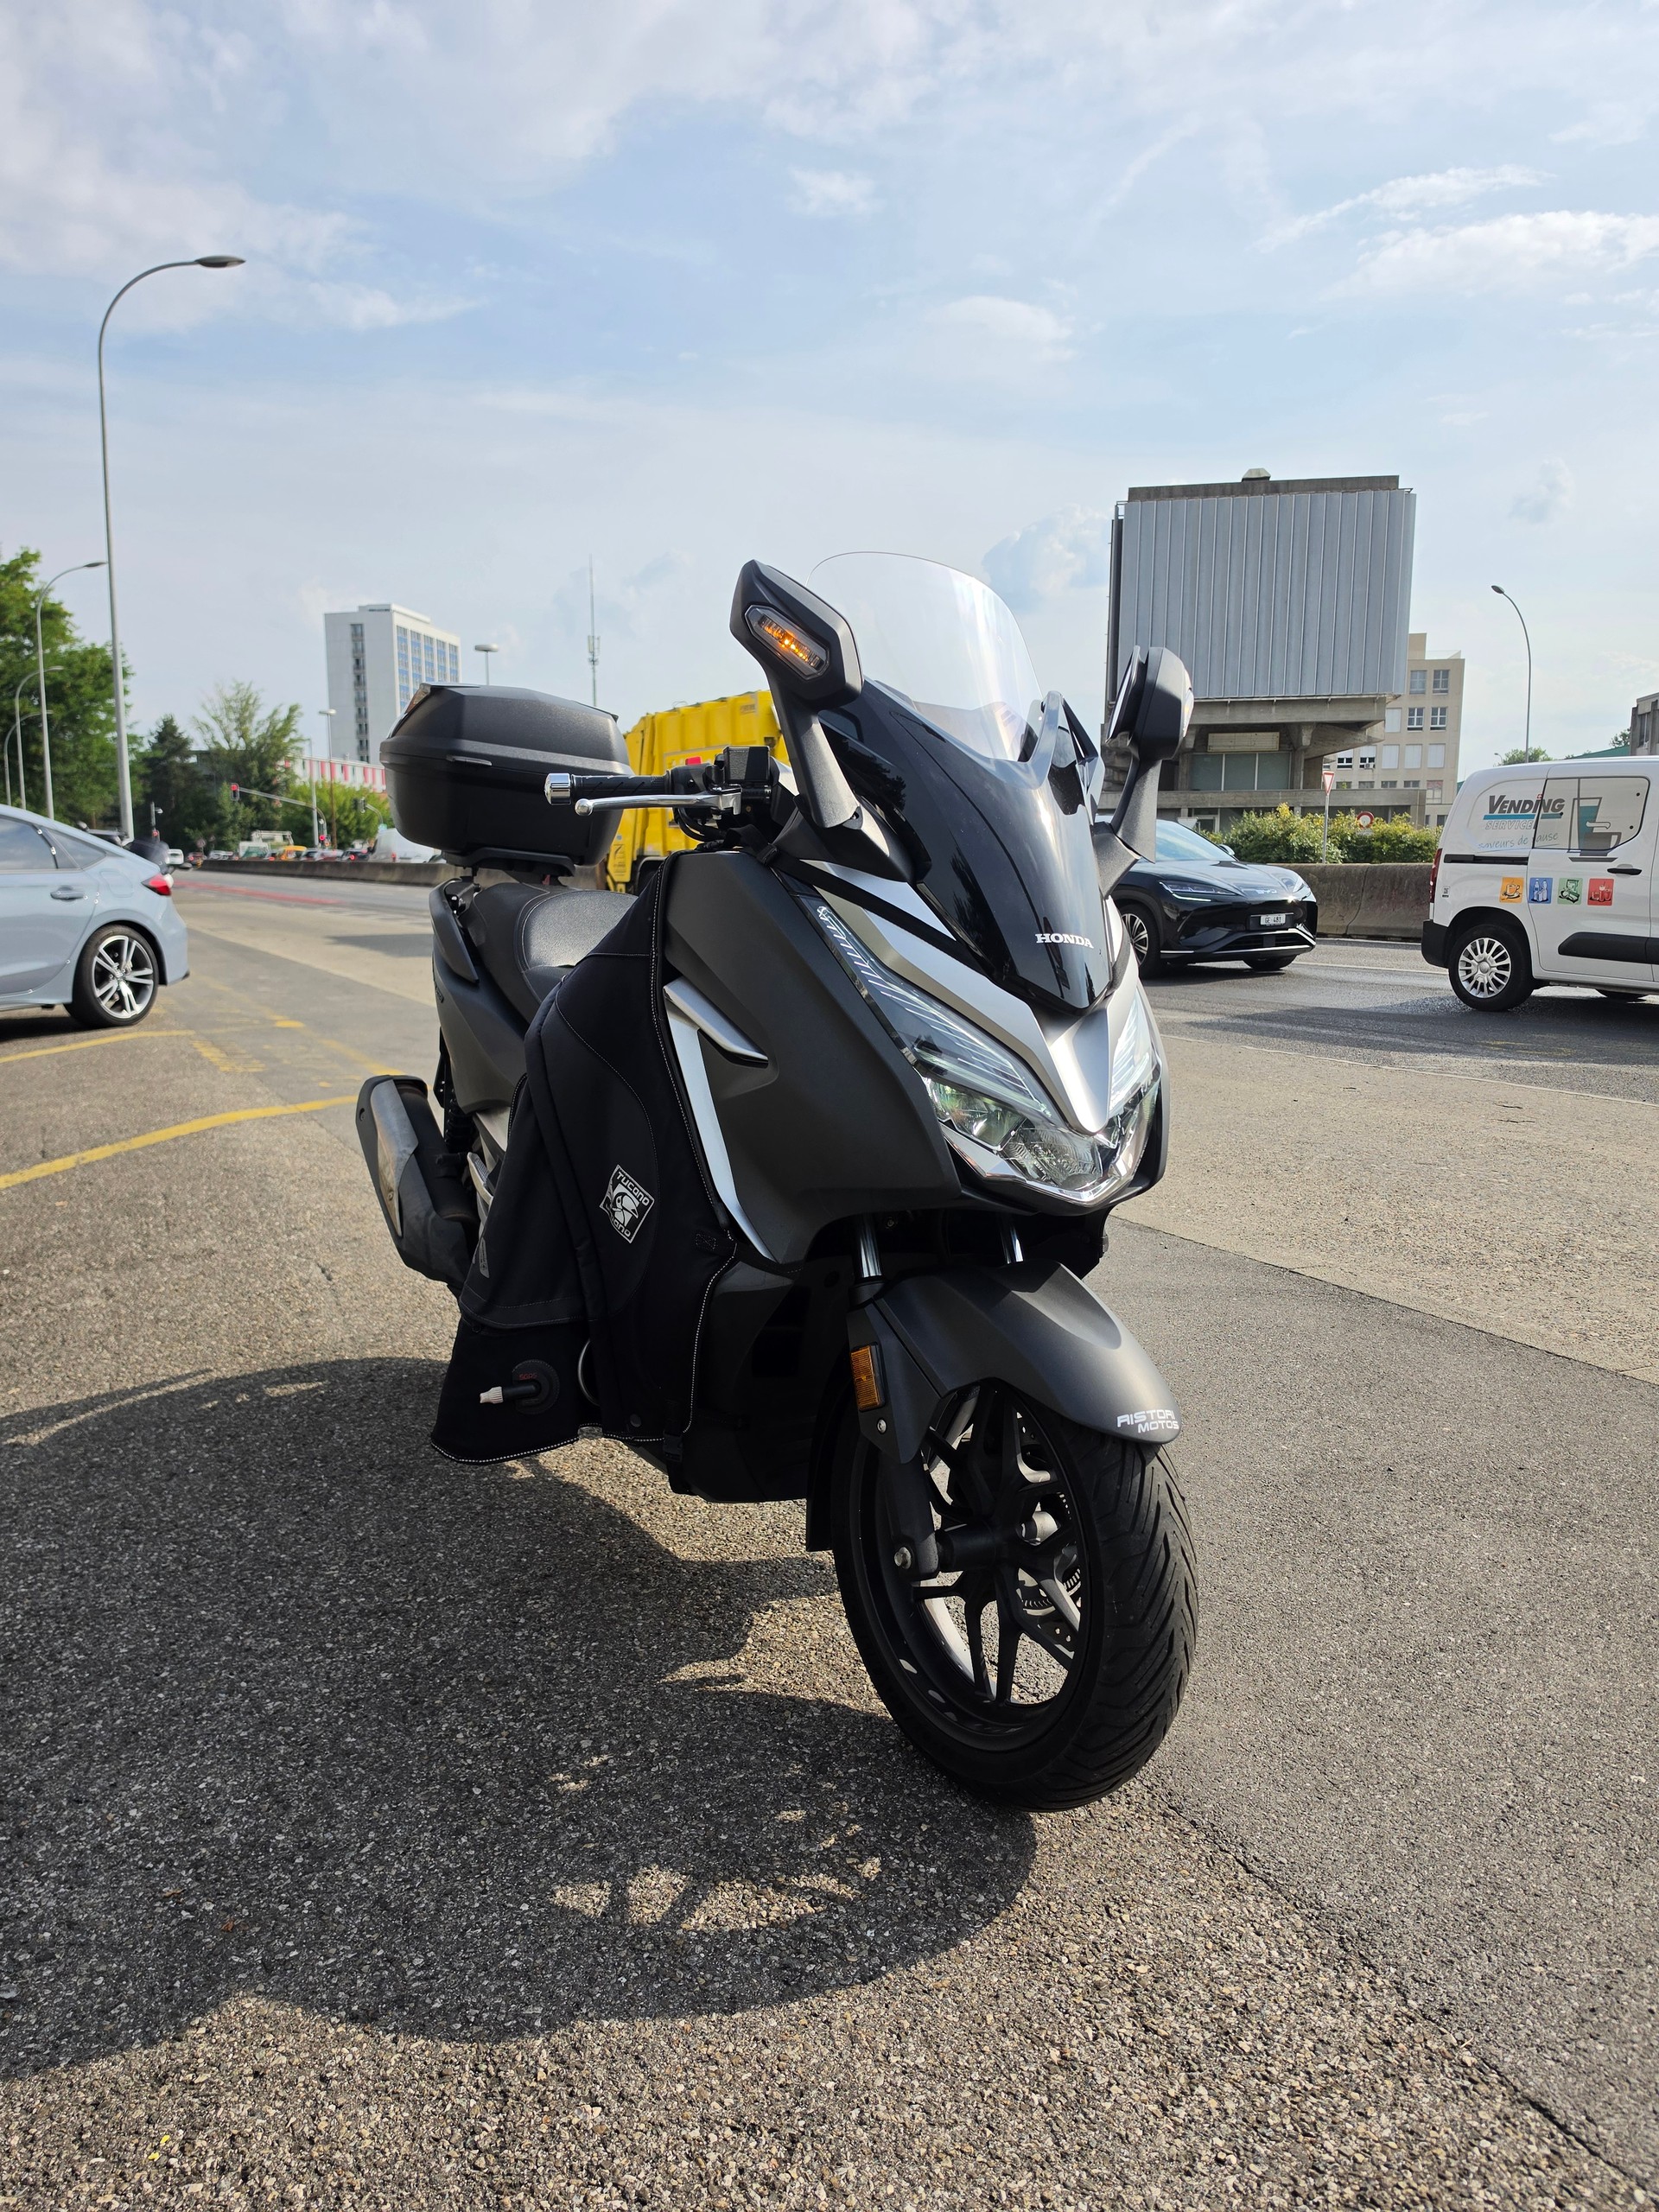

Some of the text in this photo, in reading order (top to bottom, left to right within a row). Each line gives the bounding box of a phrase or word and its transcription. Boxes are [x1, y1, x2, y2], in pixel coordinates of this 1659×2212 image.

[1488, 794, 1566, 814] VENDING
[1484, 820, 1534, 830] SERVICE
[1517, 834, 1529, 846] de
[1532, 832, 1559, 844] ause
[1035, 933, 1094, 949] HONDA
[1116, 1409, 1175, 1427] RISTORI
[1137, 1420, 1179, 1433] MOTOS
